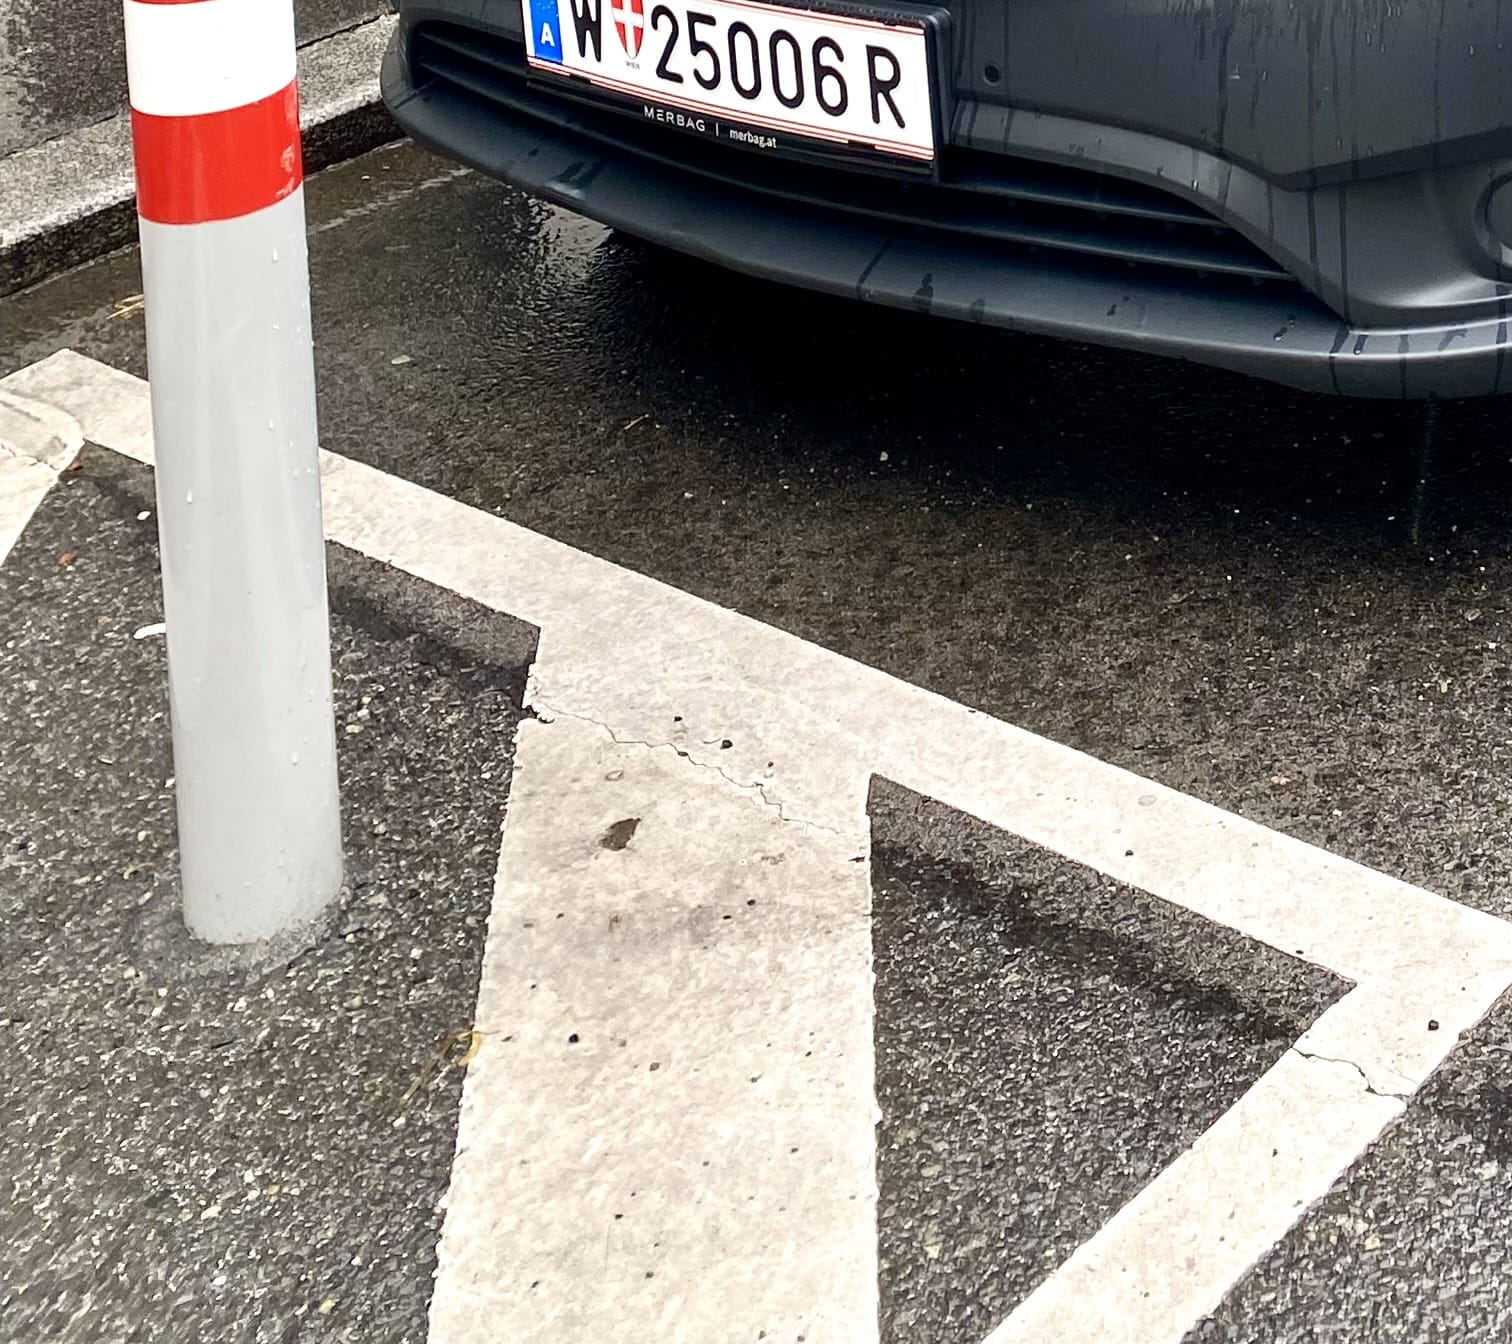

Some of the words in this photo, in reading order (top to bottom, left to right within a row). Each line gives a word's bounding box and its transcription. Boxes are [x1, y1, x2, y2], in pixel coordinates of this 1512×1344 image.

[539, 21, 556, 48] A
[643, 105, 706, 132] MERBAG
[729, 128, 778, 149] merbag.at
